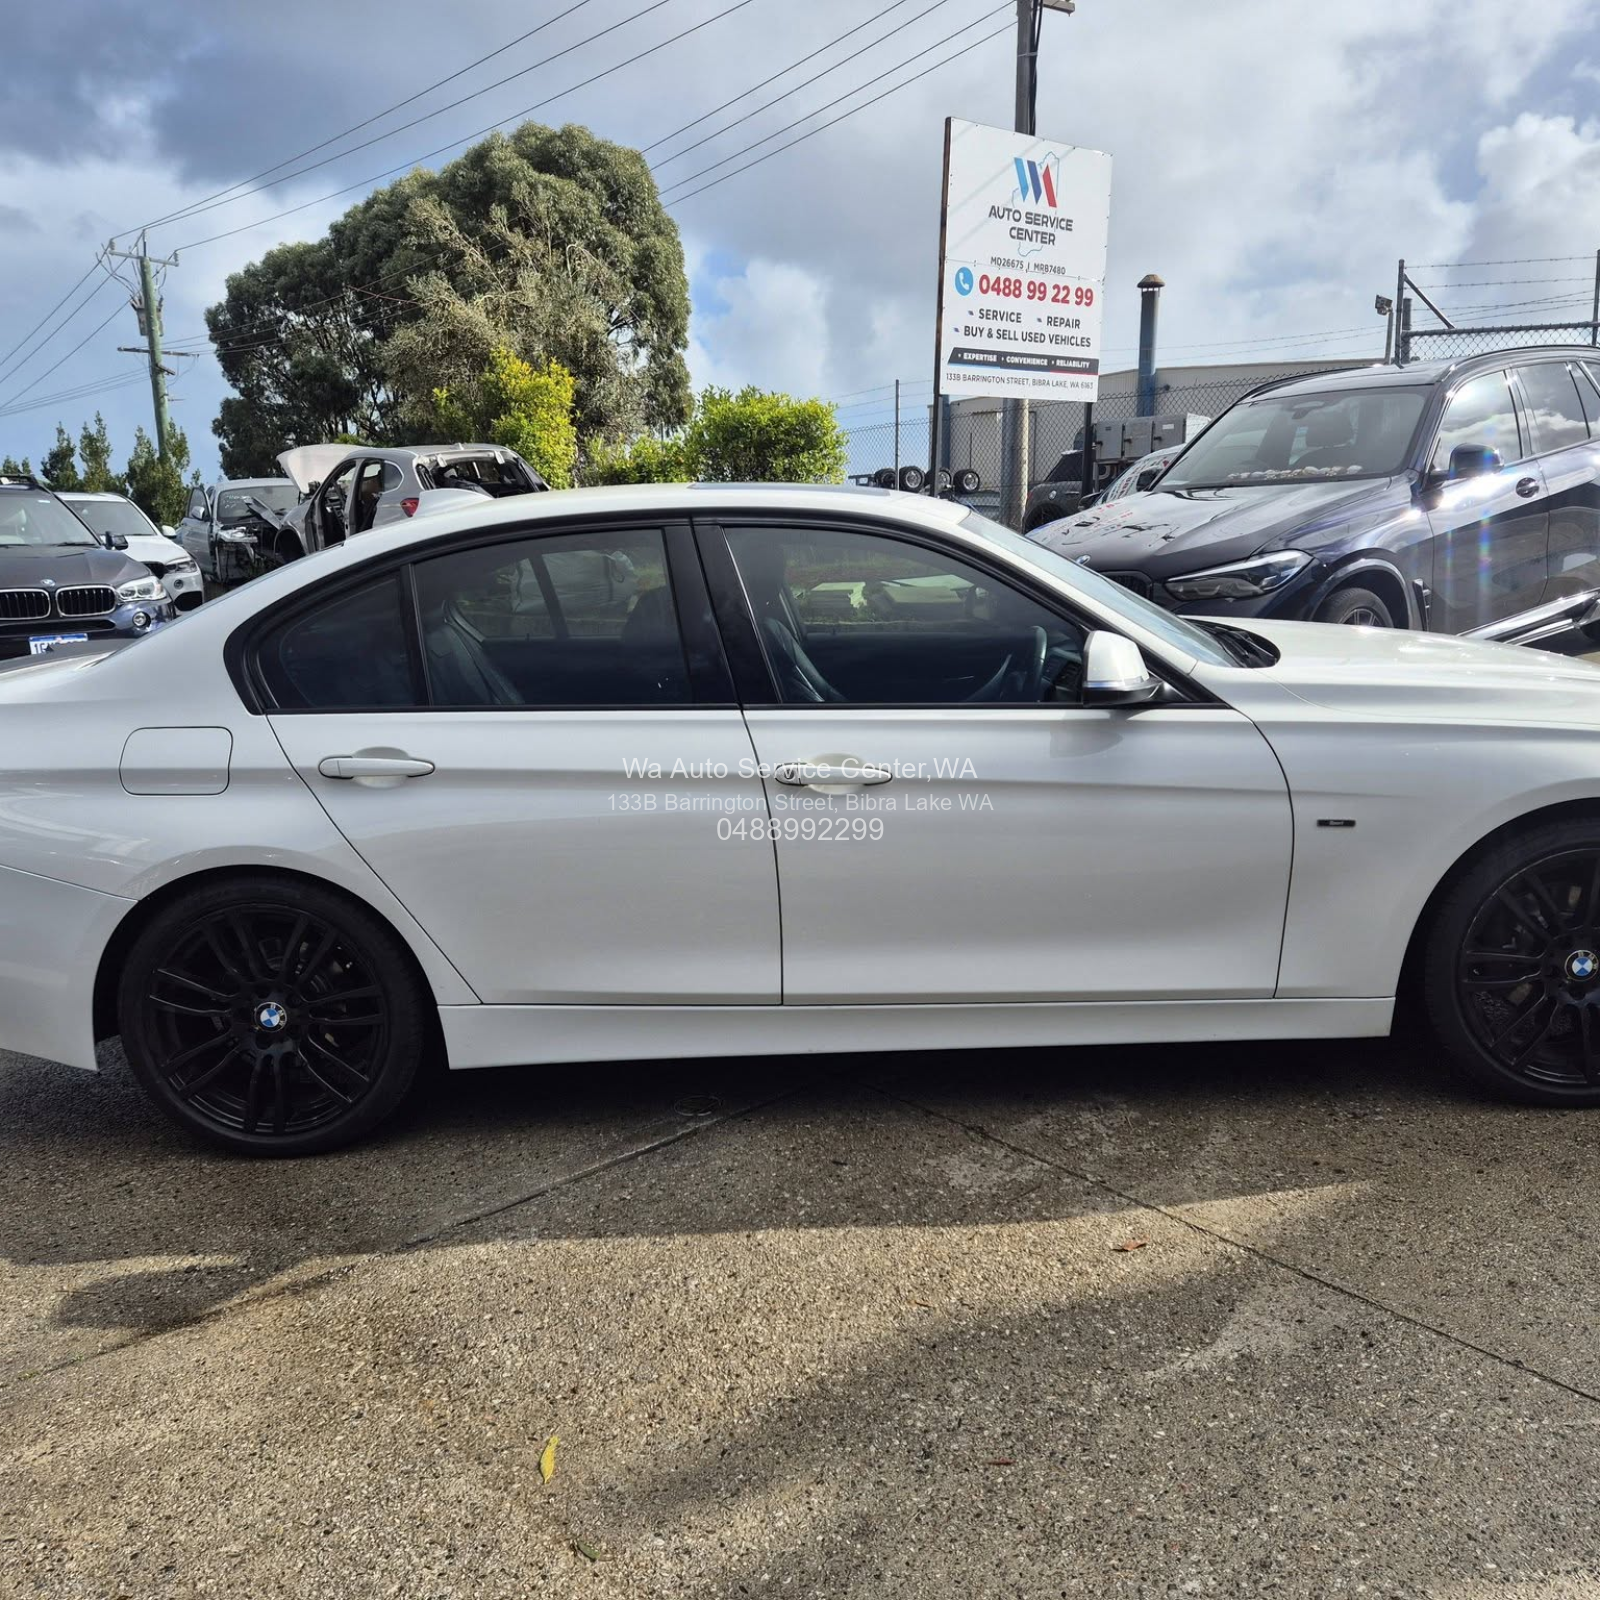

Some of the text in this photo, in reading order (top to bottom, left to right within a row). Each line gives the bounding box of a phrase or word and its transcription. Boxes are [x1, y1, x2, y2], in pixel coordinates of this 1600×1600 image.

[988, 205, 1074, 231] AUTO SERVICE
[1009, 226, 1056, 246] CENTER
[1034, 262, 1066, 274] MRB7480
[978, 274, 1094, 307] 0488 99 22 99
[978, 308, 1081, 329] SERVICE REPAIR
[964, 326, 1091, 347] BUY & SELL USED VEHICLES
[963, 352, 1090, 369] EXPERTISE CONVENIENCE RELIABILITY
[946, 373, 960, 381] 133B
[963, 373, 1005, 384] BARRINGTON
[1006, 376, 1030, 386] STREET,
[1032, 378, 1050, 387] BIBRA
